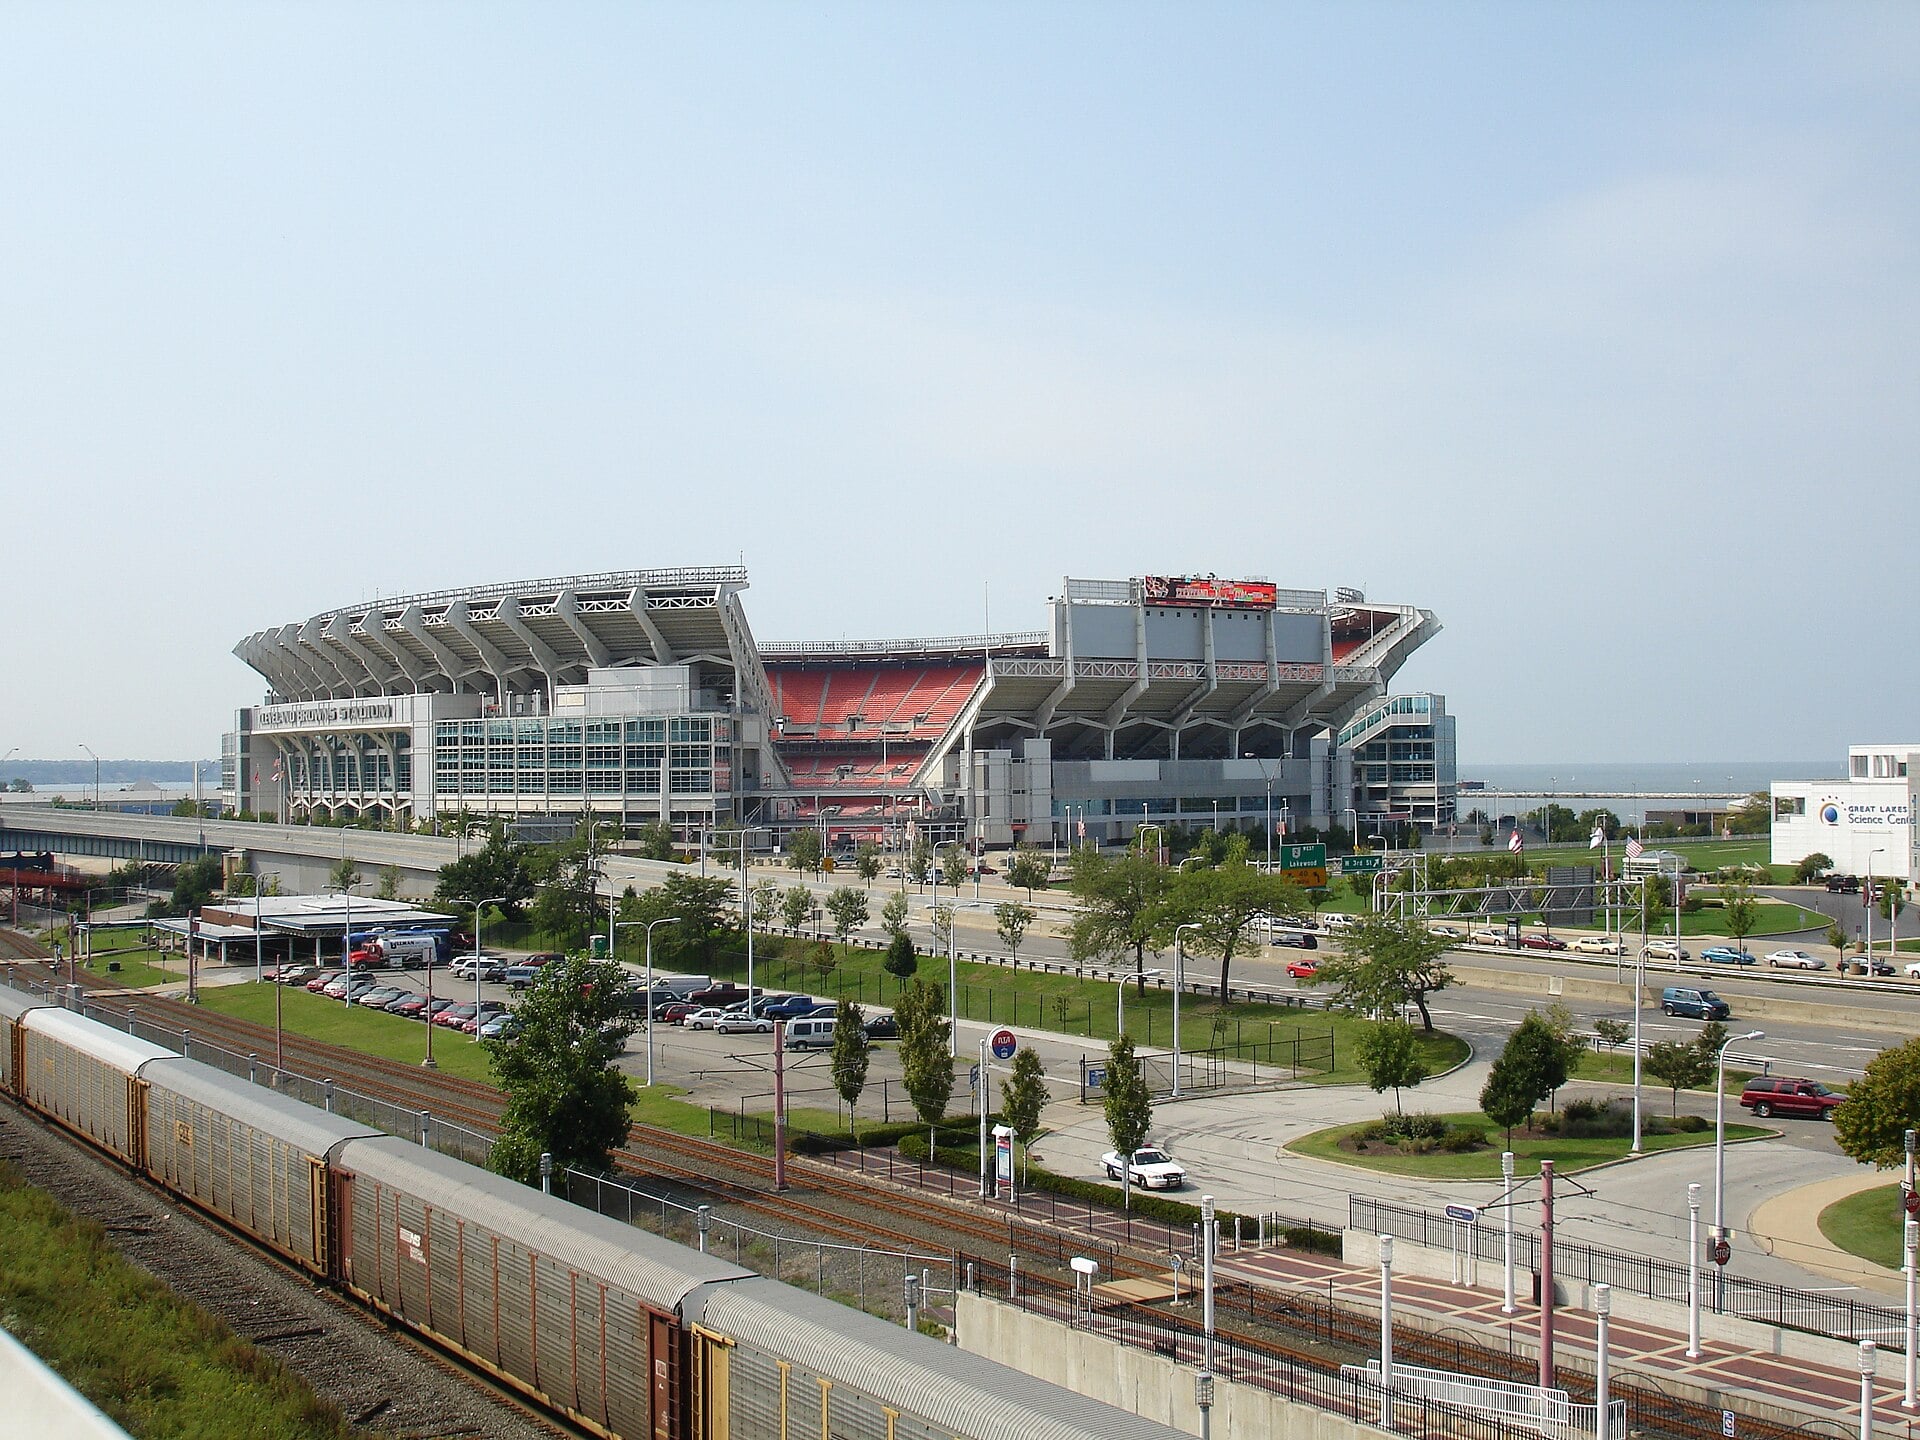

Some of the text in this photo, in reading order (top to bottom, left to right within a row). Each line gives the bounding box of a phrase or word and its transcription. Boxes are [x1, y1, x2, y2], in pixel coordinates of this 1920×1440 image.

[259, 704, 393, 725] CLEVELAND BROWNS STADIUM
[1848, 813, 1883, 824] Science
[1289, 860, 1317, 868] Lakewood
[1352, 859, 1363, 867] 3rd
[1715, 1247, 1730, 1259] STOP
